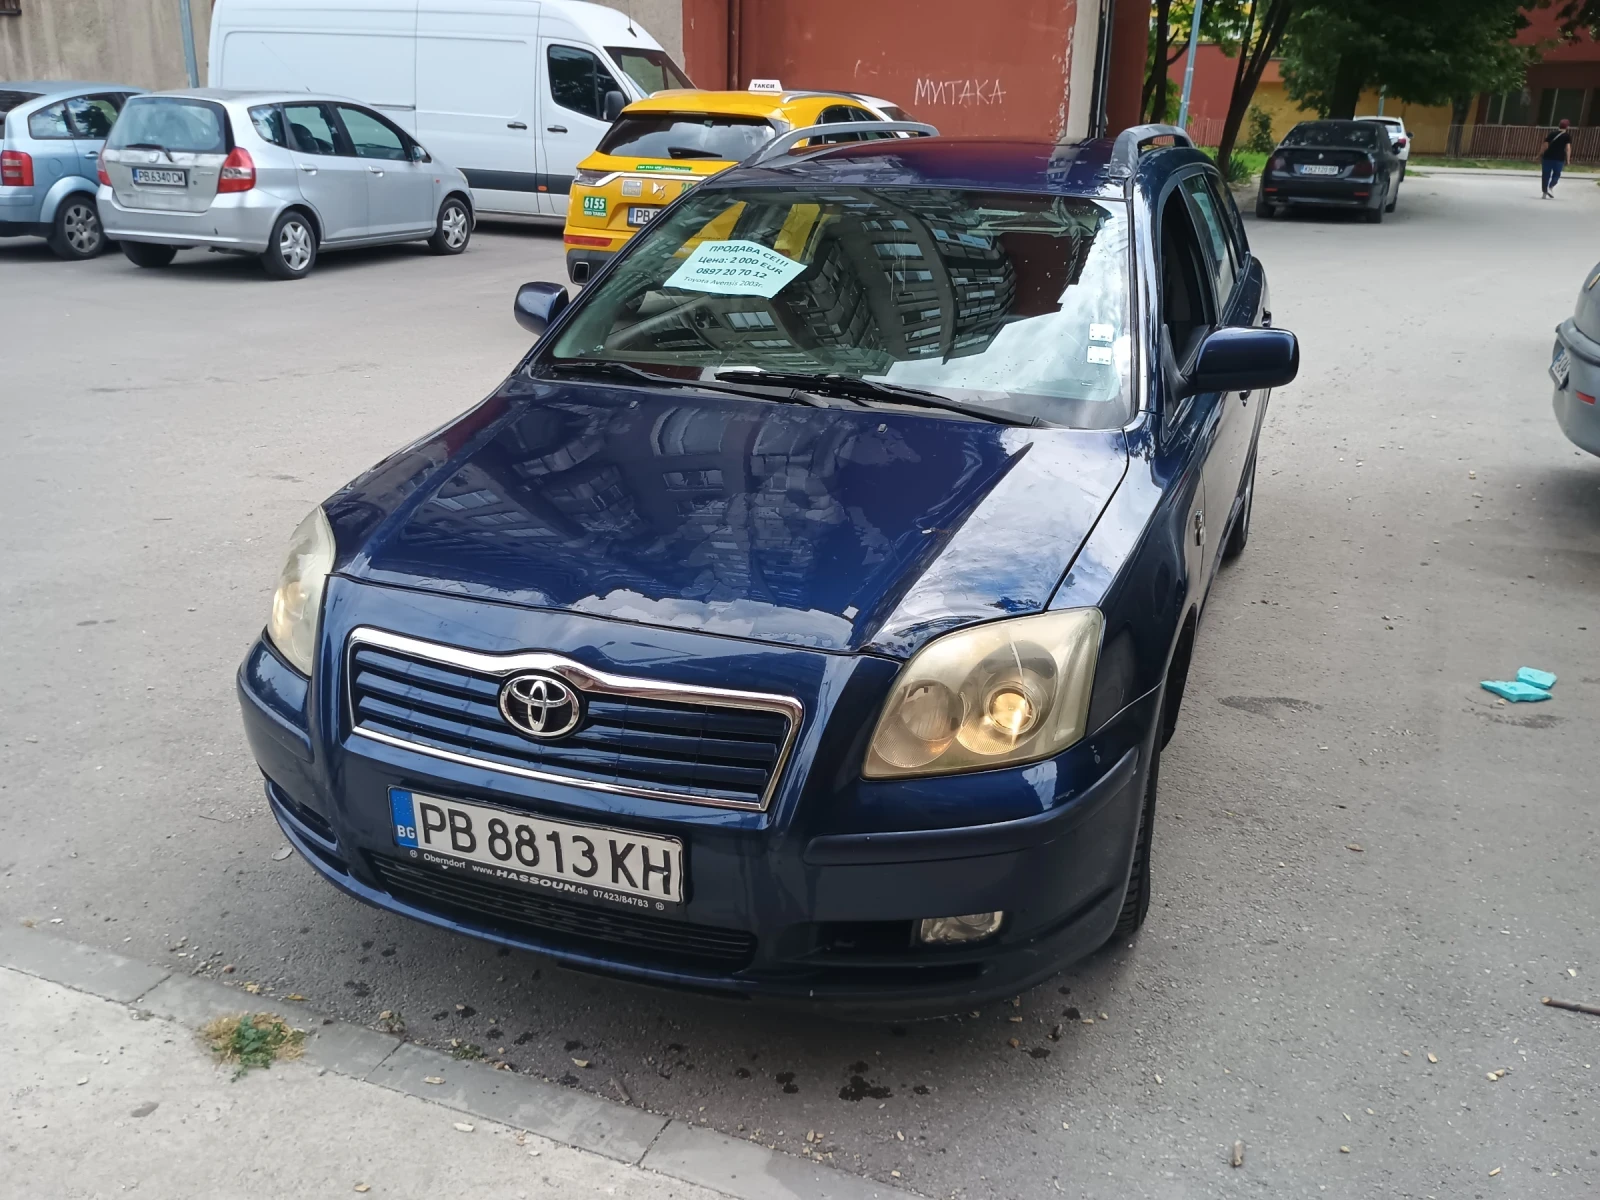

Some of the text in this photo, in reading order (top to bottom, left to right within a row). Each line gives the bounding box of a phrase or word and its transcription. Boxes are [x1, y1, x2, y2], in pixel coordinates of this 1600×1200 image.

[914, 78, 1007, 105] МИТАКА
[584, 197, 605, 209] 6155
[698, 256, 729, 264] Цена:
[738, 257, 759, 265] 000
[760, 262, 784, 275] EUR
[709, 245, 789, 267] ПРОДАВА СЕ!!!
[684, 276, 709, 284] Toyota
[711, 279, 739, 287] Avensis
[696, 267, 722, 275] 0897
[752, 271, 768, 279] 12
[397, 825, 416, 839] BG
[419, 802, 672, 895] PB 8813 KH
[423, 853, 466, 869] Oberndorf
[593, 889, 649, 908] 07423/84783
